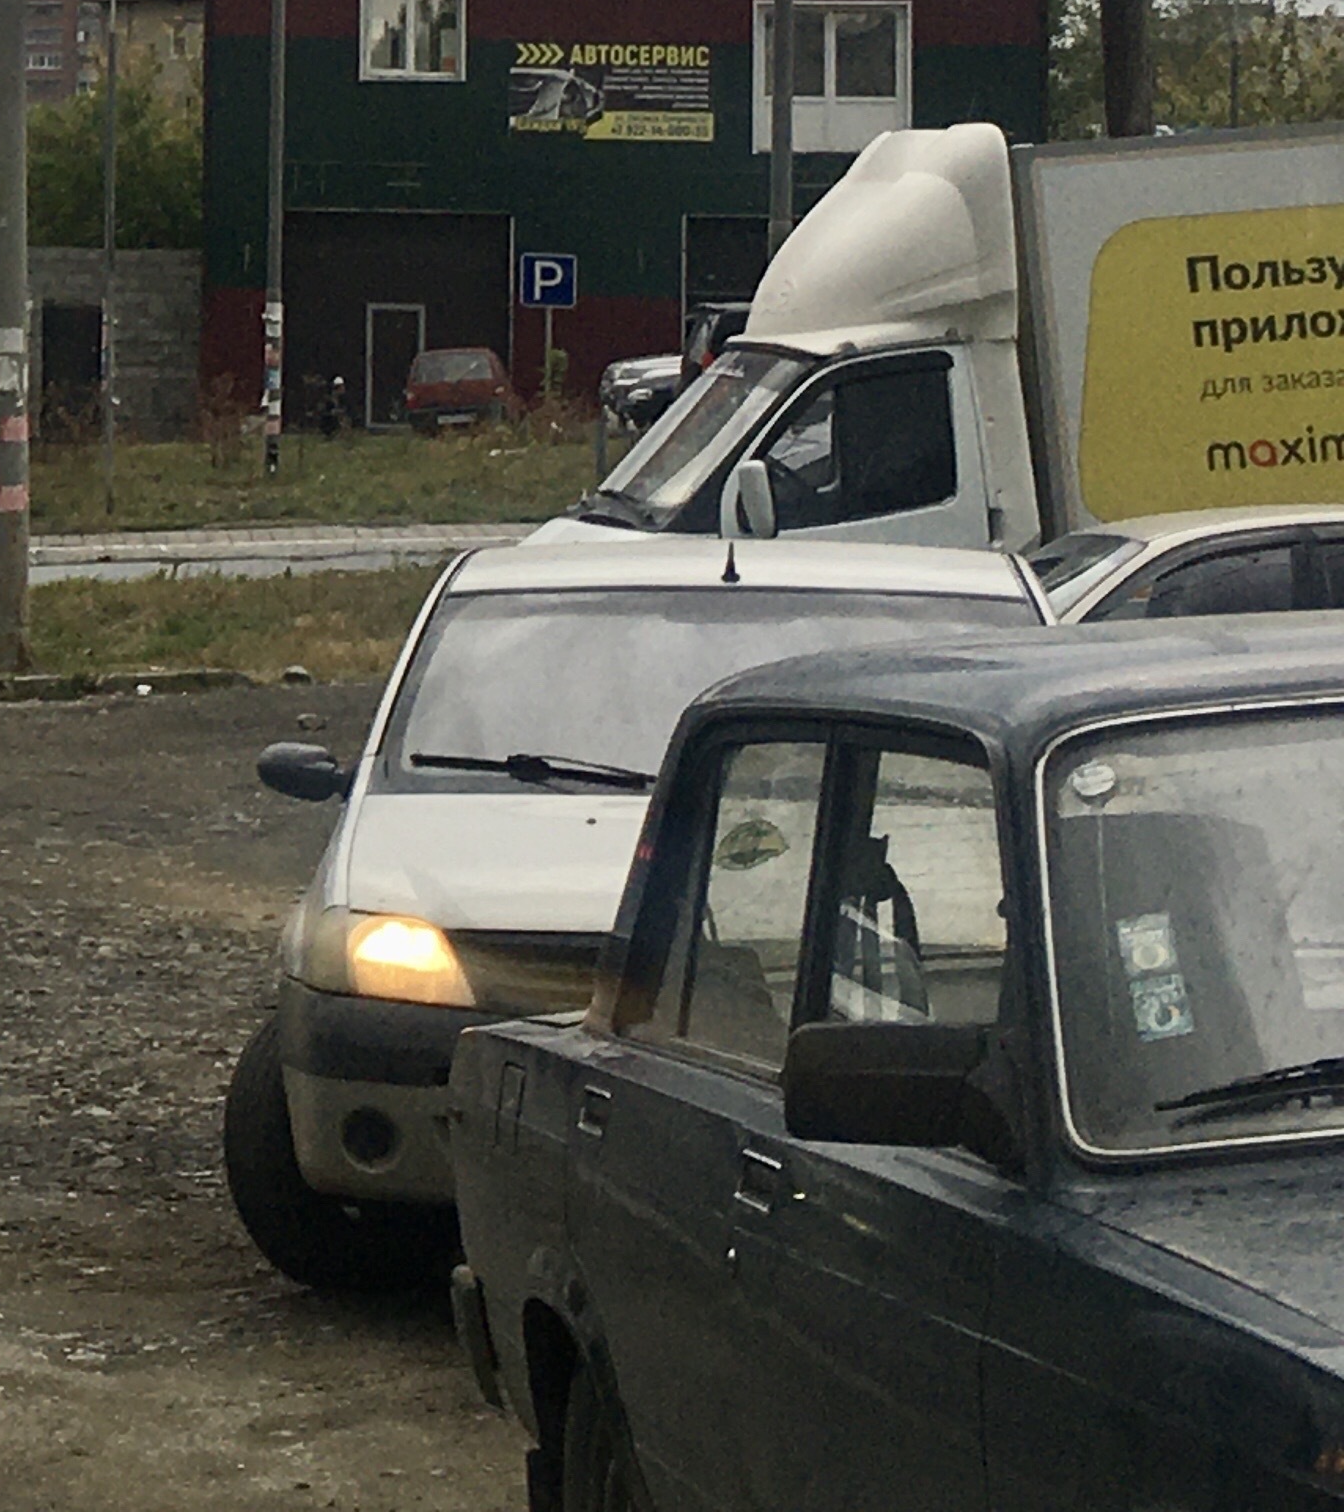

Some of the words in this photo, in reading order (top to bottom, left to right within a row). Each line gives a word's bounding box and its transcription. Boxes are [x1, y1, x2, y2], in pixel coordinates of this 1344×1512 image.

[570, 43, 710, 67] АВТОСЕРВИС
[1186, 254, 1344, 293] Пользу
[1200, 376, 1253, 402] для
[1262, 369, 1344, 393] заказа
[1206, 425, 1344, 472] maxim
